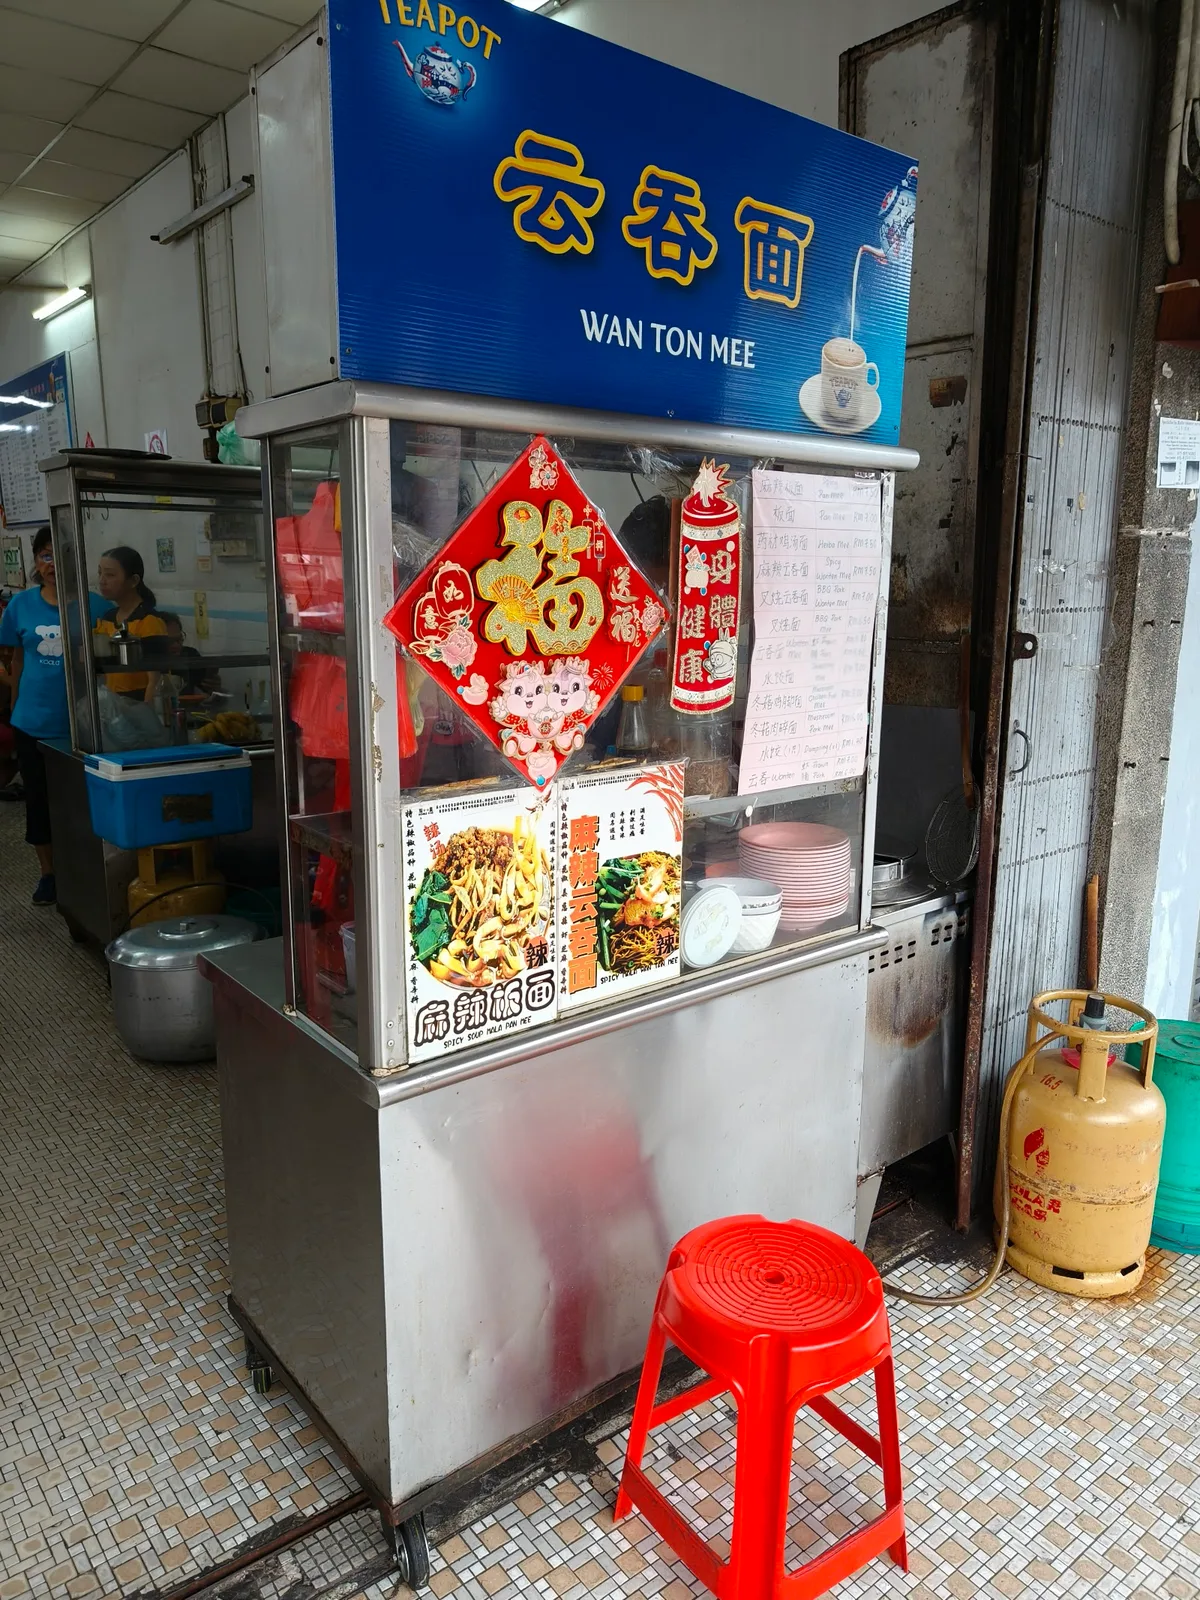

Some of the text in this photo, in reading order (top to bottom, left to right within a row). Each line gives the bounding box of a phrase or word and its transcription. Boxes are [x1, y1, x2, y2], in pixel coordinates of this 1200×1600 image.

[379, 0, 502, 60] TEAPOT
[494, 130, 815, 309] 云吞面
[580, 309, 755, 369] WAN TON MEE
[773, 505, 795, 523] 板面
[476, 500, 604, 656] 福
[756, 560, 809, 579] 麻辣云吞面
[610, 566, 639, 643] 送福
[709, 550, 737, 629] 身體
[759, 589, 809, 608] 叉烧云吞面
[680, 604, 706, 684] 健康
[769, 617, 801, 633] 叉烧面
[423, 821, 446, 860] 辣汤
[568, 814, 600, 995] 麻辣云吞面
[526, 939, 549, 970] 辣
[656, 932, 675, 956] 辣
[600, 973, 619, 985] SPICY
[413, 969, 556, 1048] 麻辣板面
[443, 1015, 533, 1049] SPICY SOUP MALA PAN MEE
[1039, 1073, 1064, 1090] 16.5
